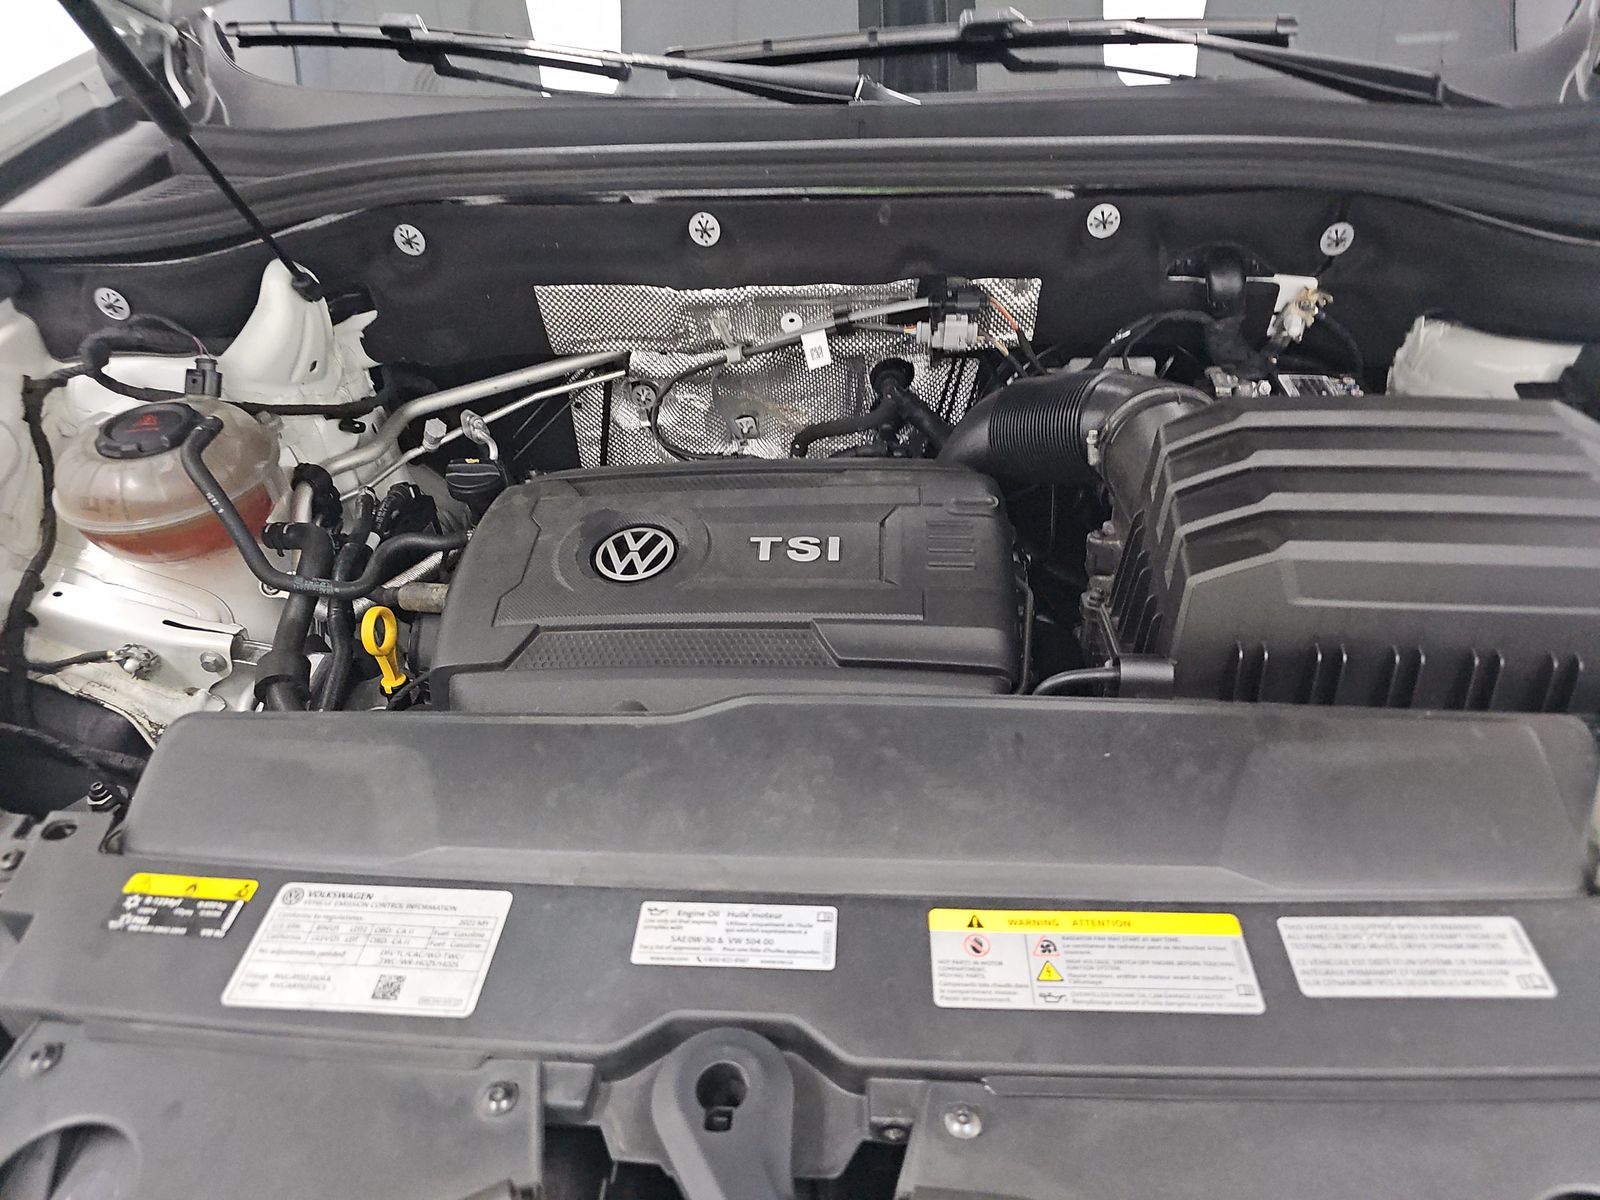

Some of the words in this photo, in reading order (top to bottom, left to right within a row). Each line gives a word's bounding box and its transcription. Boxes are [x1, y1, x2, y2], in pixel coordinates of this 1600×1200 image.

[750, 536, 841, 562] TSI
[308, 891, 374, 900] VOLKSWAGEN
[303, 899, 332, 907] VEHICLE
[333, 900, 369, 908] EMISSION
[370, 902, 403, 910] CONTROL
[405, 903, 457, 912] INFORMATION
[677, 910, 705, 918] Engine
[1008, 918, 1059, 927] WARNING
[1072, 918, 1131, 928] ATTENTION
[671, 935, 686, 943] SAE
